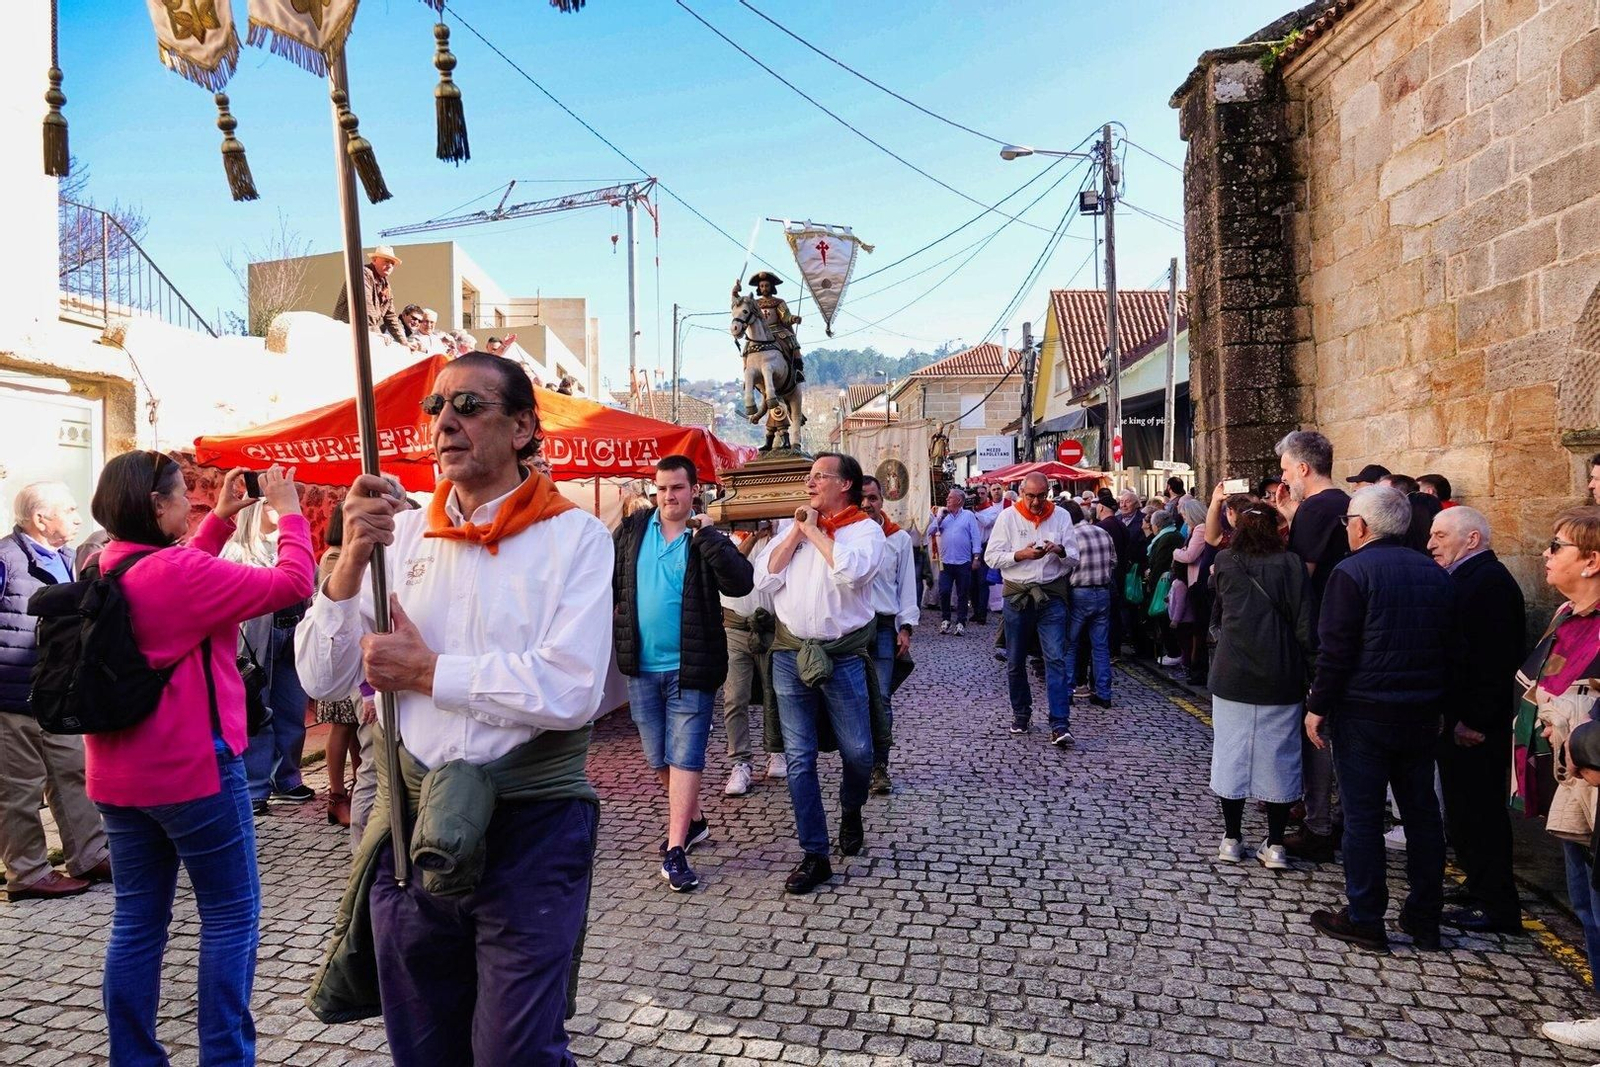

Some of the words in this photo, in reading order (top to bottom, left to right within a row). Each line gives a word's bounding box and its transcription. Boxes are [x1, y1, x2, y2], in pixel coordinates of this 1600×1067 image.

[1129, 416, 1146, 427] king
[1146, 416, 1156, 427] of
[541, 436, 661, 466] DICIA
